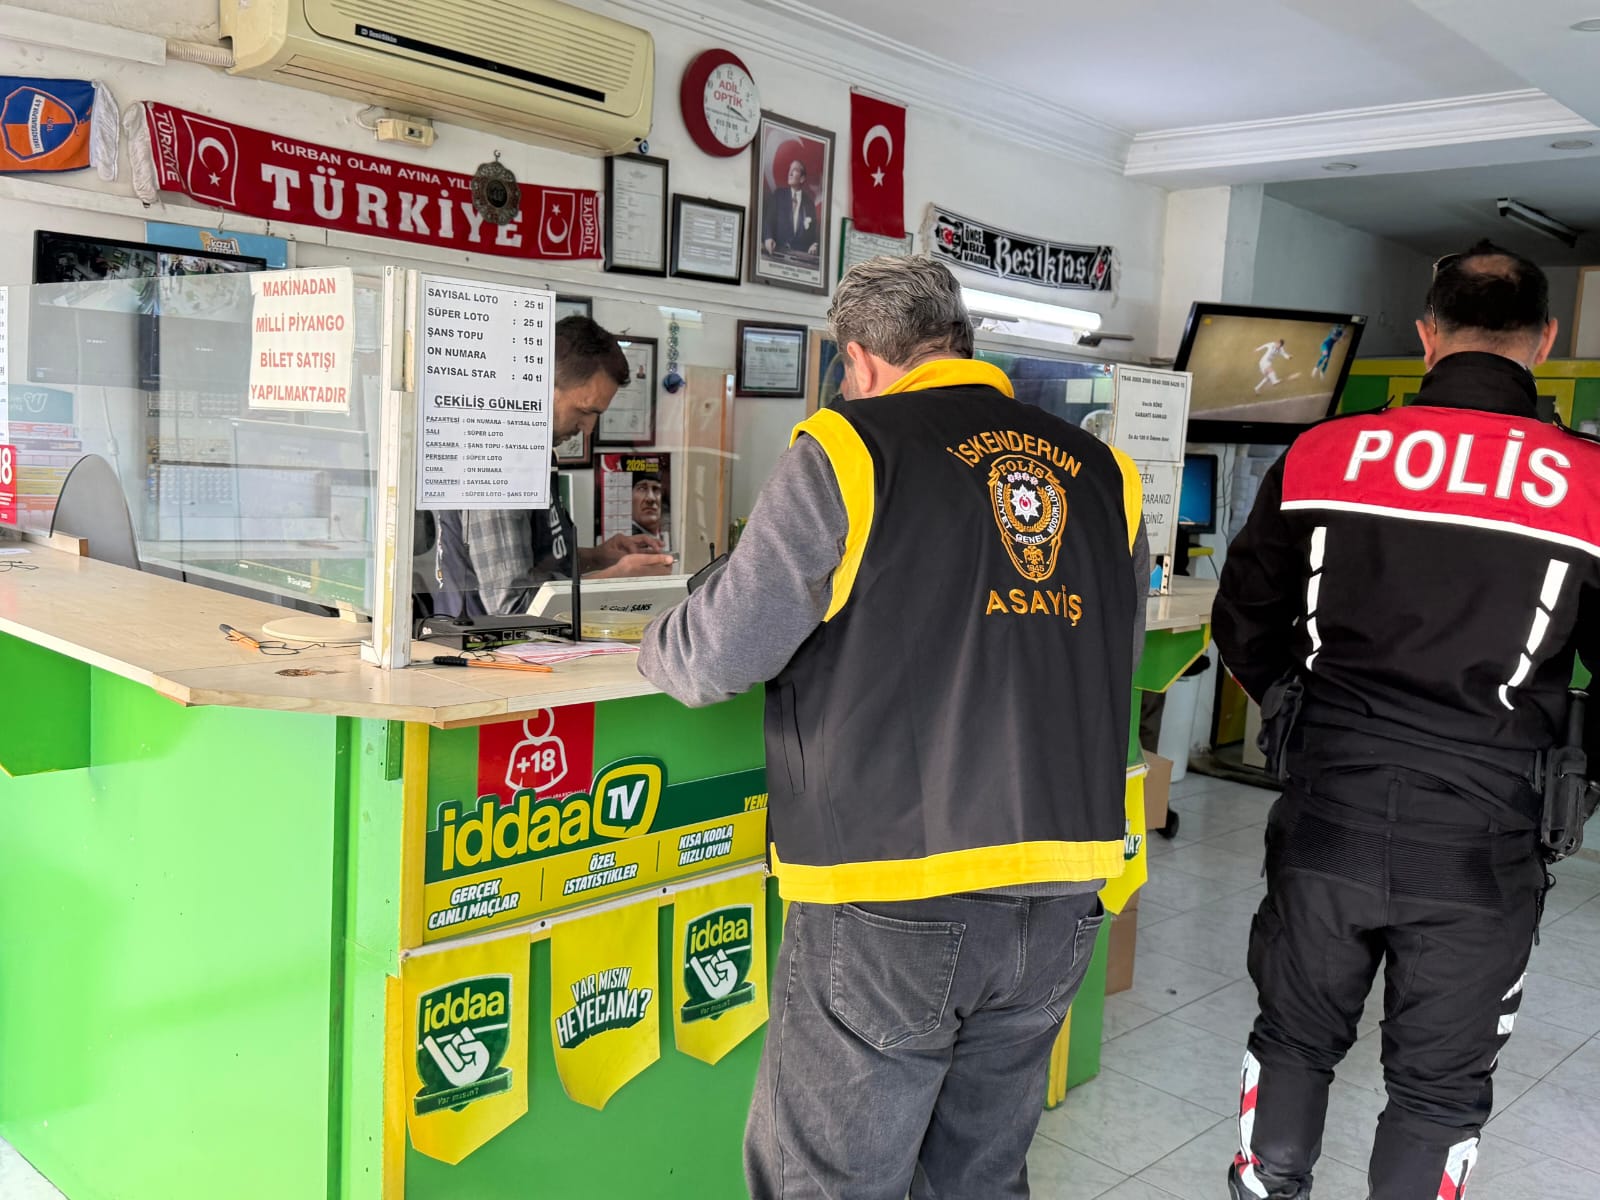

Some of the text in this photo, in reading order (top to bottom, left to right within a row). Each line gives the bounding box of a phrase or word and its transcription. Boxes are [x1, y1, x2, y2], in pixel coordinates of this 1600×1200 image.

[714, 90, 743, 109] OPTİK
[719, 80, 740, 95] ADİL
[154, 111, 180, 183] TÜRKİYE
[271, 140, 341, 166] KURBAN
[347, 157, 392, 176] OLAM
[398, 167, 441, 186] AYINA
[260, 163, 523, 248] TÜRKİYE
[582, 196, 593, 253] TÜRKİYE
[262, 277, 336, 298] MAKİNADAN
[428, 288, 471, 302] SAYISAL
[473, 293, 499, 305] LOTO
[524, 300, 535, 309] 25
[537, 301, 544, 310] tl
[256, 314, 345, 333] MİLLİ PİYANGO
[428, 307, 461, 320] SÜPER
[464, 310, 490, 322] LOTO
[523, 318, 535, 328] 25
[537, 319, 543, 328] tl
[427, 327, 455, 338] ŞANS
[457, 330, 484, 341] TOPU
[523, 337, 534, 346] 15
[536, 337, 543, 346] tl
[260, 351, 336, 373] BİLET SATIŞI
[427, 346, 442, 356] ON
[445, 348, 487, 360] NUMARA
[524, 355, 534, 365] 15
[537, 356, 543, 365] tl
[427, 365, 469, 377] SAYISAL
[472, 369, 497, 379] STAR
[522, 373, 534, 383] 40
[535, 373, 542, 382] tl
[251, 383, 347, 404] YAPILMAKTADIR
[434, 394, 542, 412] ÇEKİLİŞ GÜNLERİ
[626, 459, 645, 471] 2026
[946, 430, 1082, 478] İSKENDERUN
[998, 460, 1045, 479] POLİS
[1343, 427, 1571, 508] POLİS
[1015, 533, 1047, 544] GENEL
[985, 584, 1083, 627] ASAYİŞ
[516, 748, 557, 773] +18
[442, 795, 592, 871] iddaa
[608, 780, 646, 822] TV
[679, 825, 733, 851] KISA KODLA
[590, 853, 616, 872] ÖZEL
[679, 842, 731, 866] HIZLI OYUN
[564, 864, 638, 896] İSTATİSTİKLER
[452, 879, 502, 906] GERÇEK
[428, 893, 519, 930] CANLI MAÇLAR
[690, 915, 748, 954] iddaa
[571, 967, 632, 1003] VAR MISIN
[423, 987, 504, 1033] iddaa
[556, 989, 653, 1047] HEYECANA?
